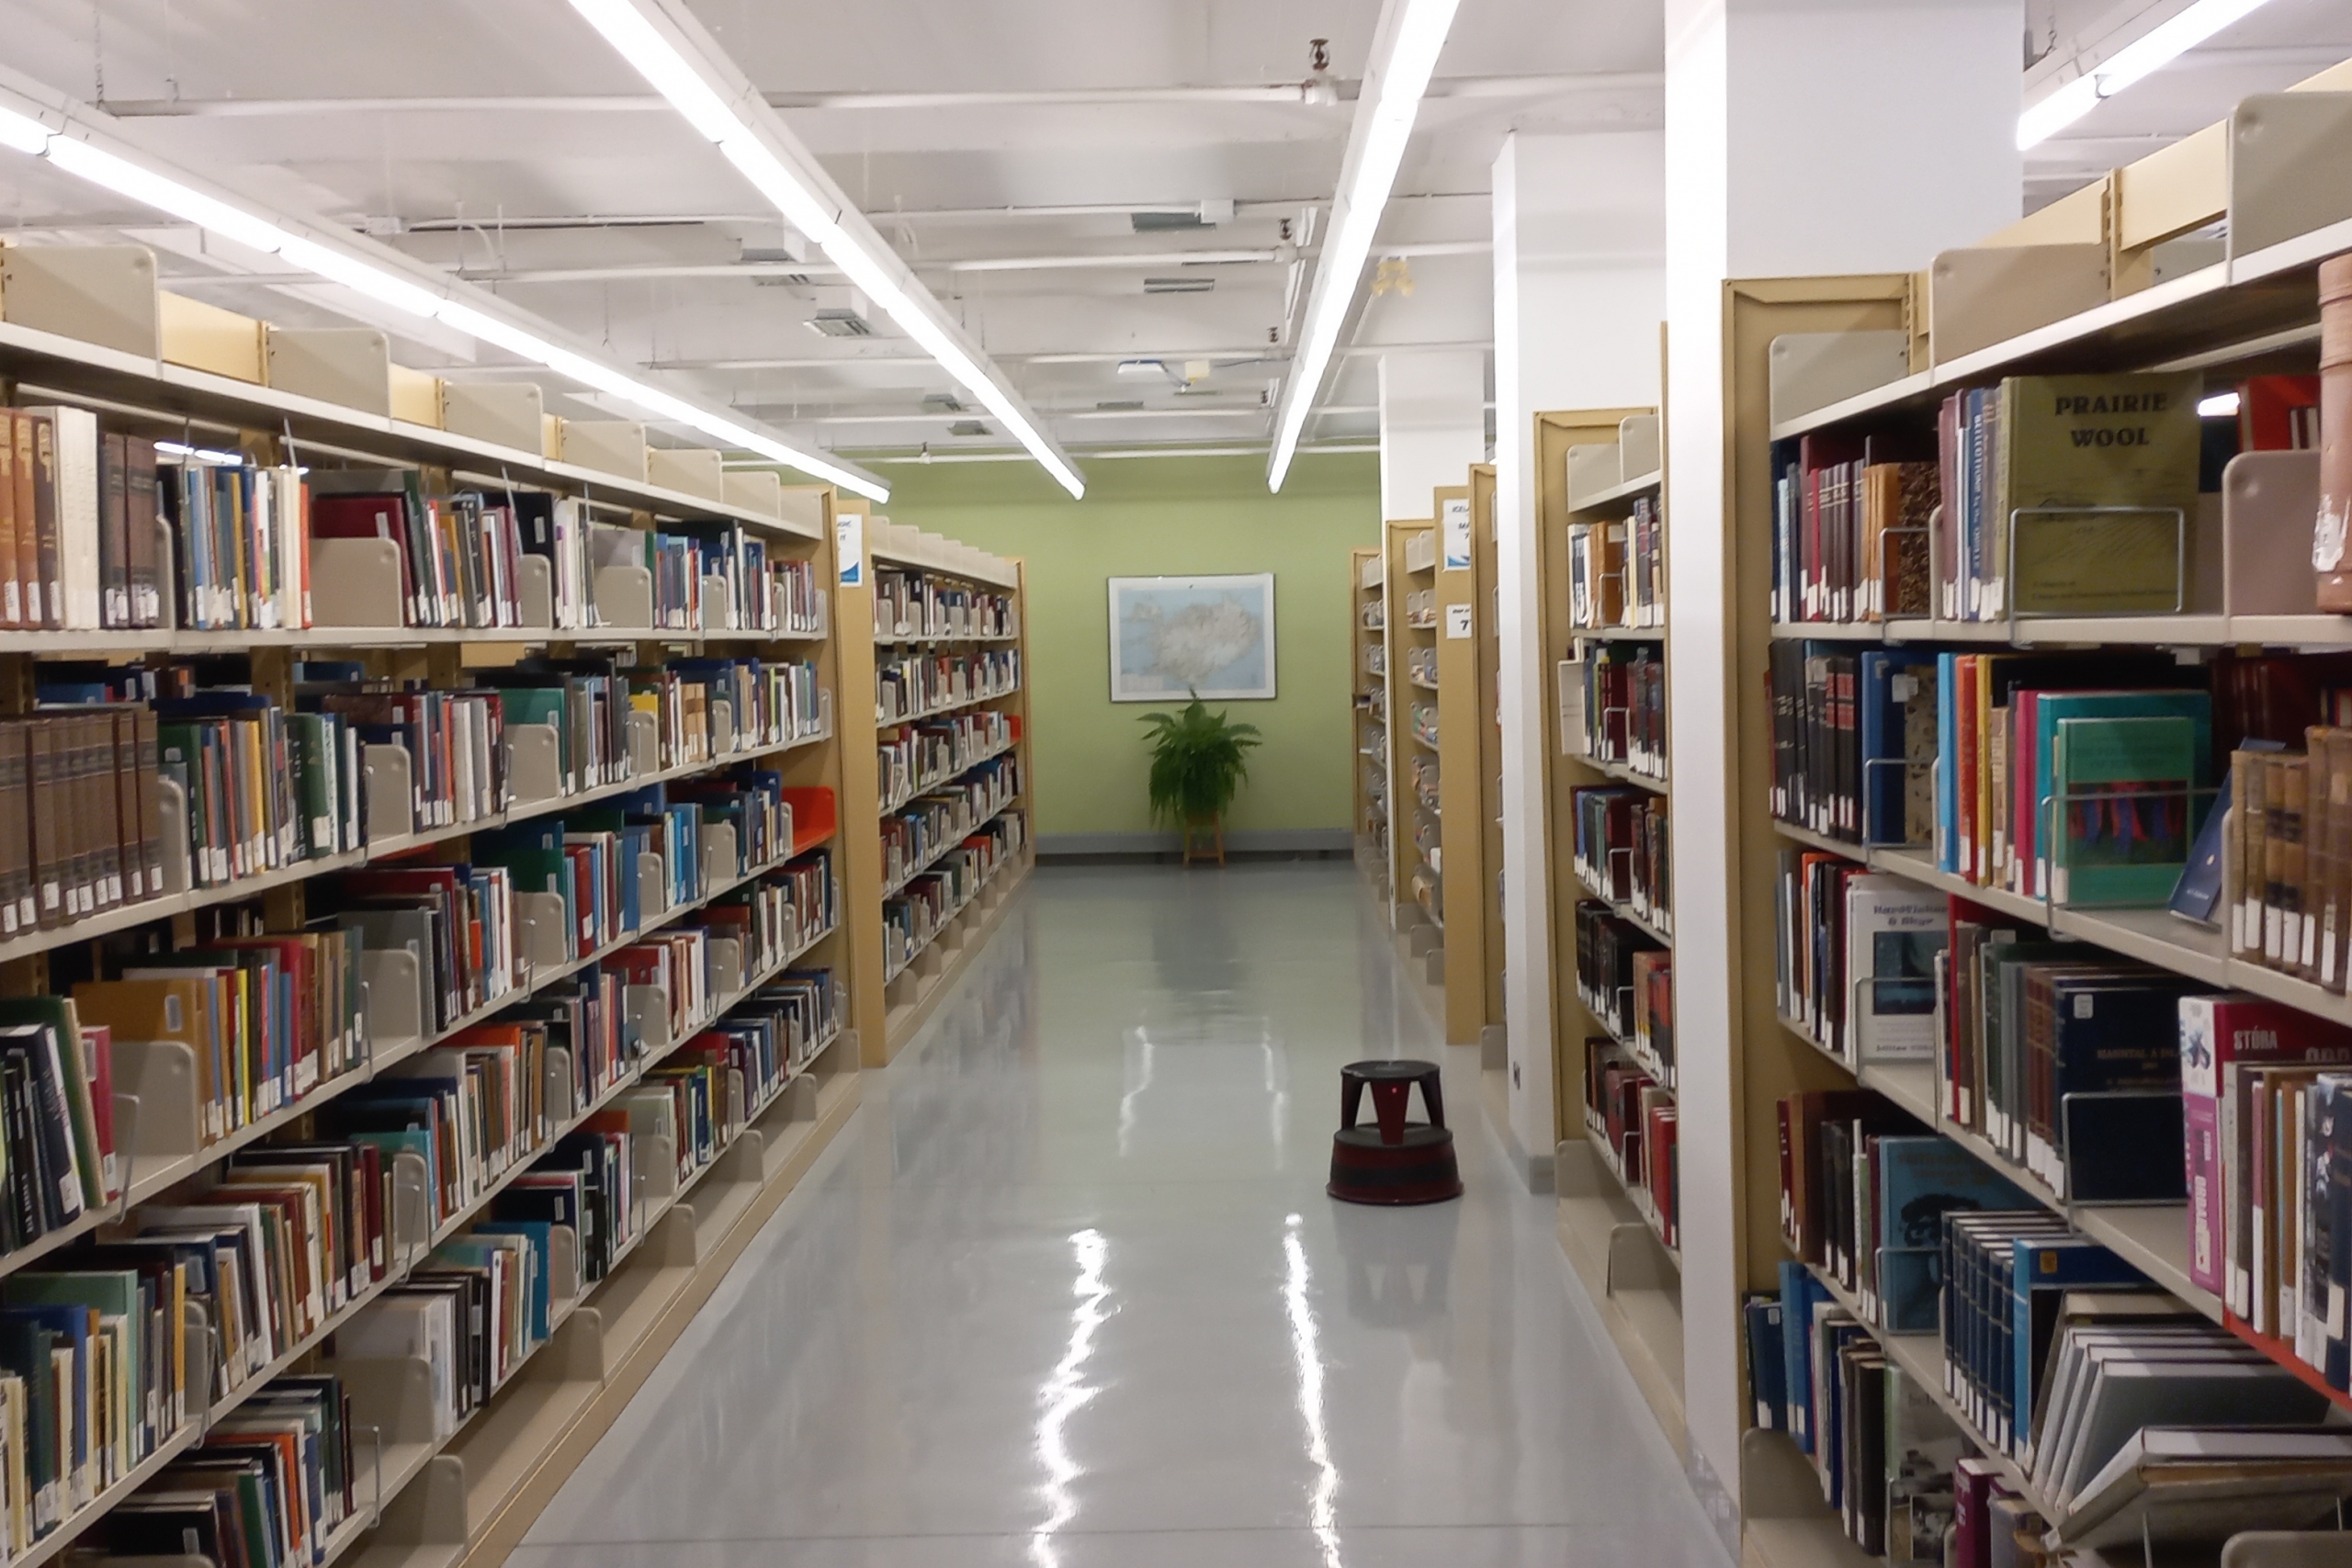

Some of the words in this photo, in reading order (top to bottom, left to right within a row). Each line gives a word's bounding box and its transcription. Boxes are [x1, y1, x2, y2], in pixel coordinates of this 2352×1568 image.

[2054, 393, 2167, 416] PRAIRIE
[2071, 427, 2150, 448] WOOL
[2233, 1025, 2278, 1050] STÓRA
